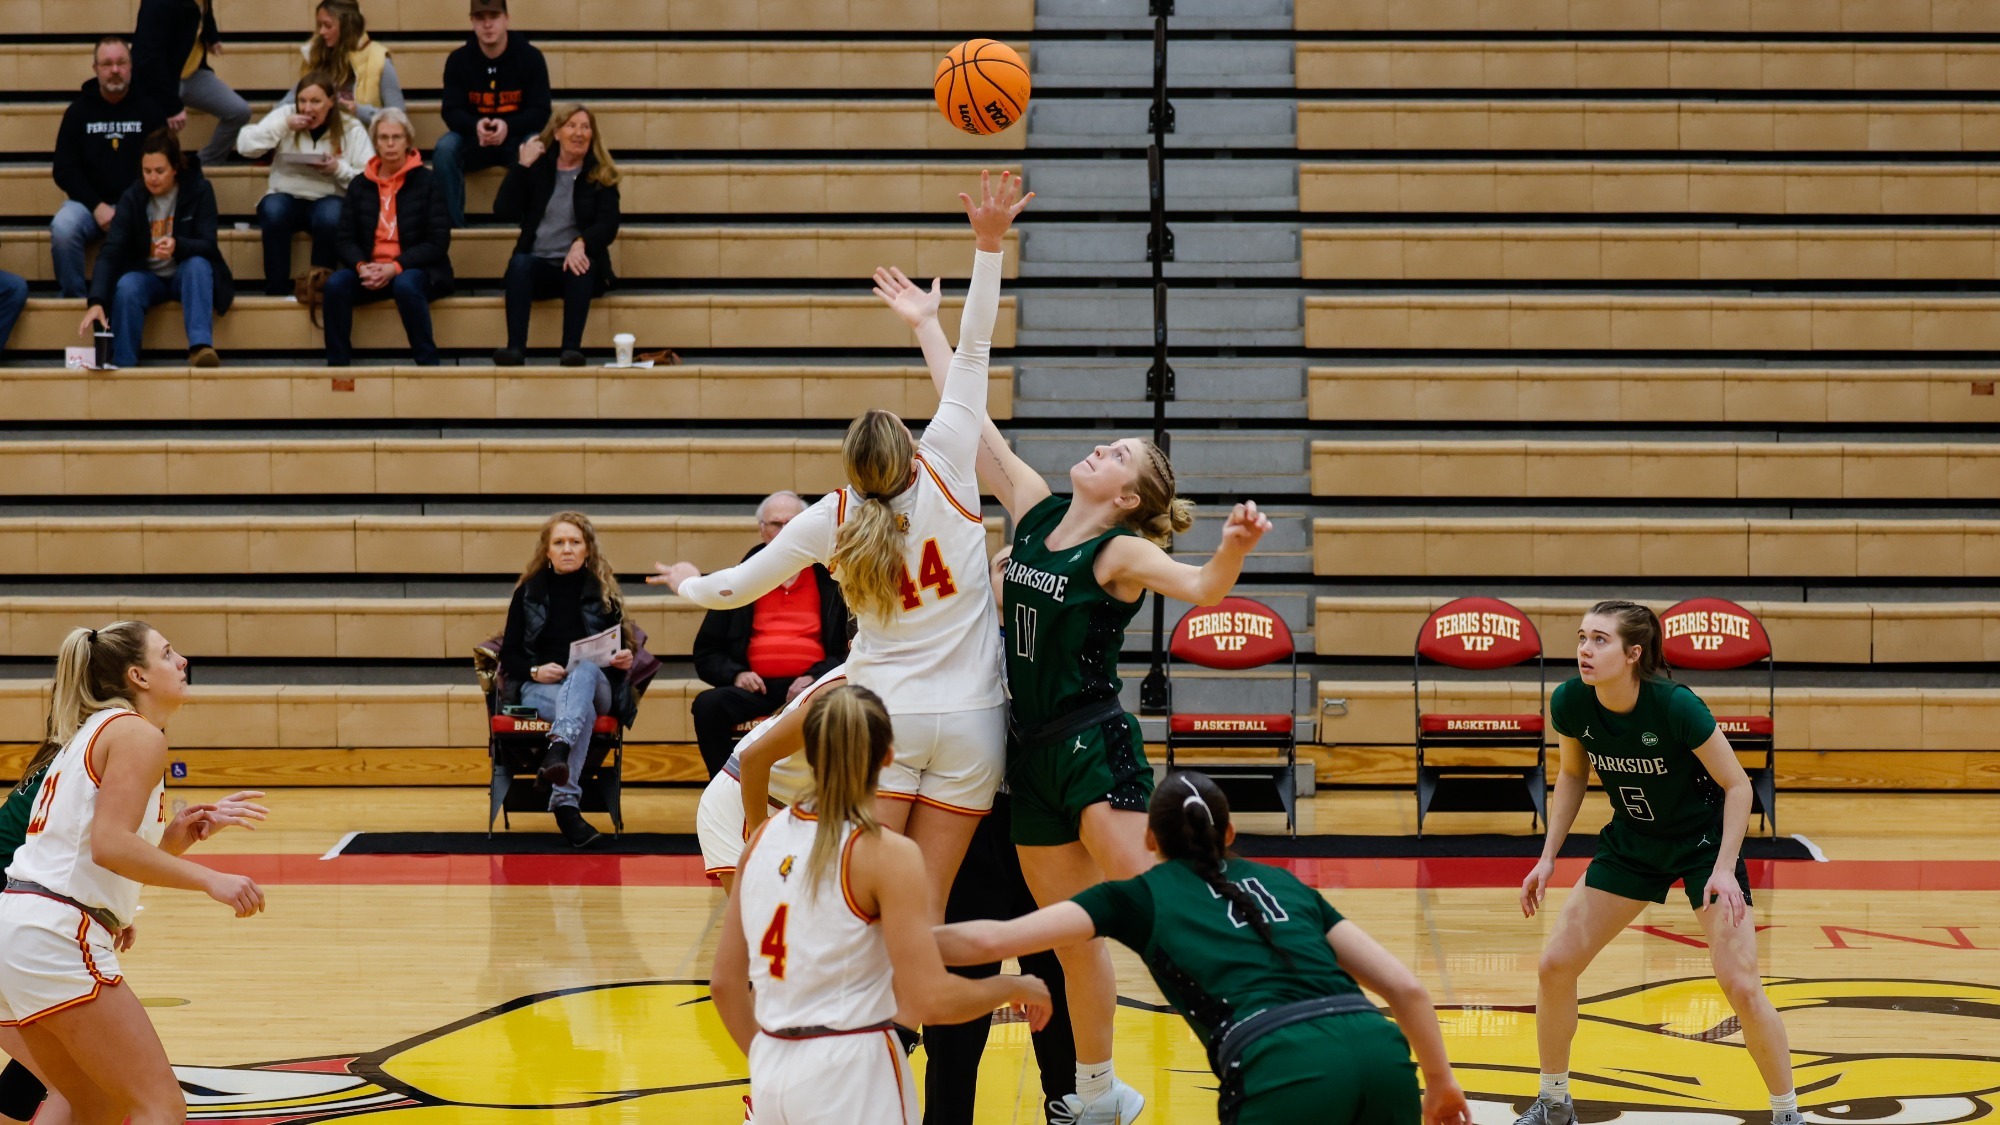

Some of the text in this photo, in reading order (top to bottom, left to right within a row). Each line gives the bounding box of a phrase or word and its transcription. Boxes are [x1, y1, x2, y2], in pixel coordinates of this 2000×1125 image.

[116, 121, 142, 133] STATE
[1015, 602, 1037, 663] 11
[1188, 611, 1274, 640] FERRIS STATE
[1435, 611, 1521, 641] FERRIS STATE
[1664, 610, 1750, 640] FERRIS STATE
[1213, 635, 1248, 651] VIP
[1461, 635, 1495, 651] VIP
[1690, 634, 1724, 651] VIP
[1193, 720, 1268, 731] BASKETBALL
[1447, 720, 1521, 731] BASKETBALL
[1587, 750, 1668, 776] PARKSIDE
[26, 770, 62, 837] 21
[1619, 786, 1655, 821] 5
[760, 902, 789, 981] 4
